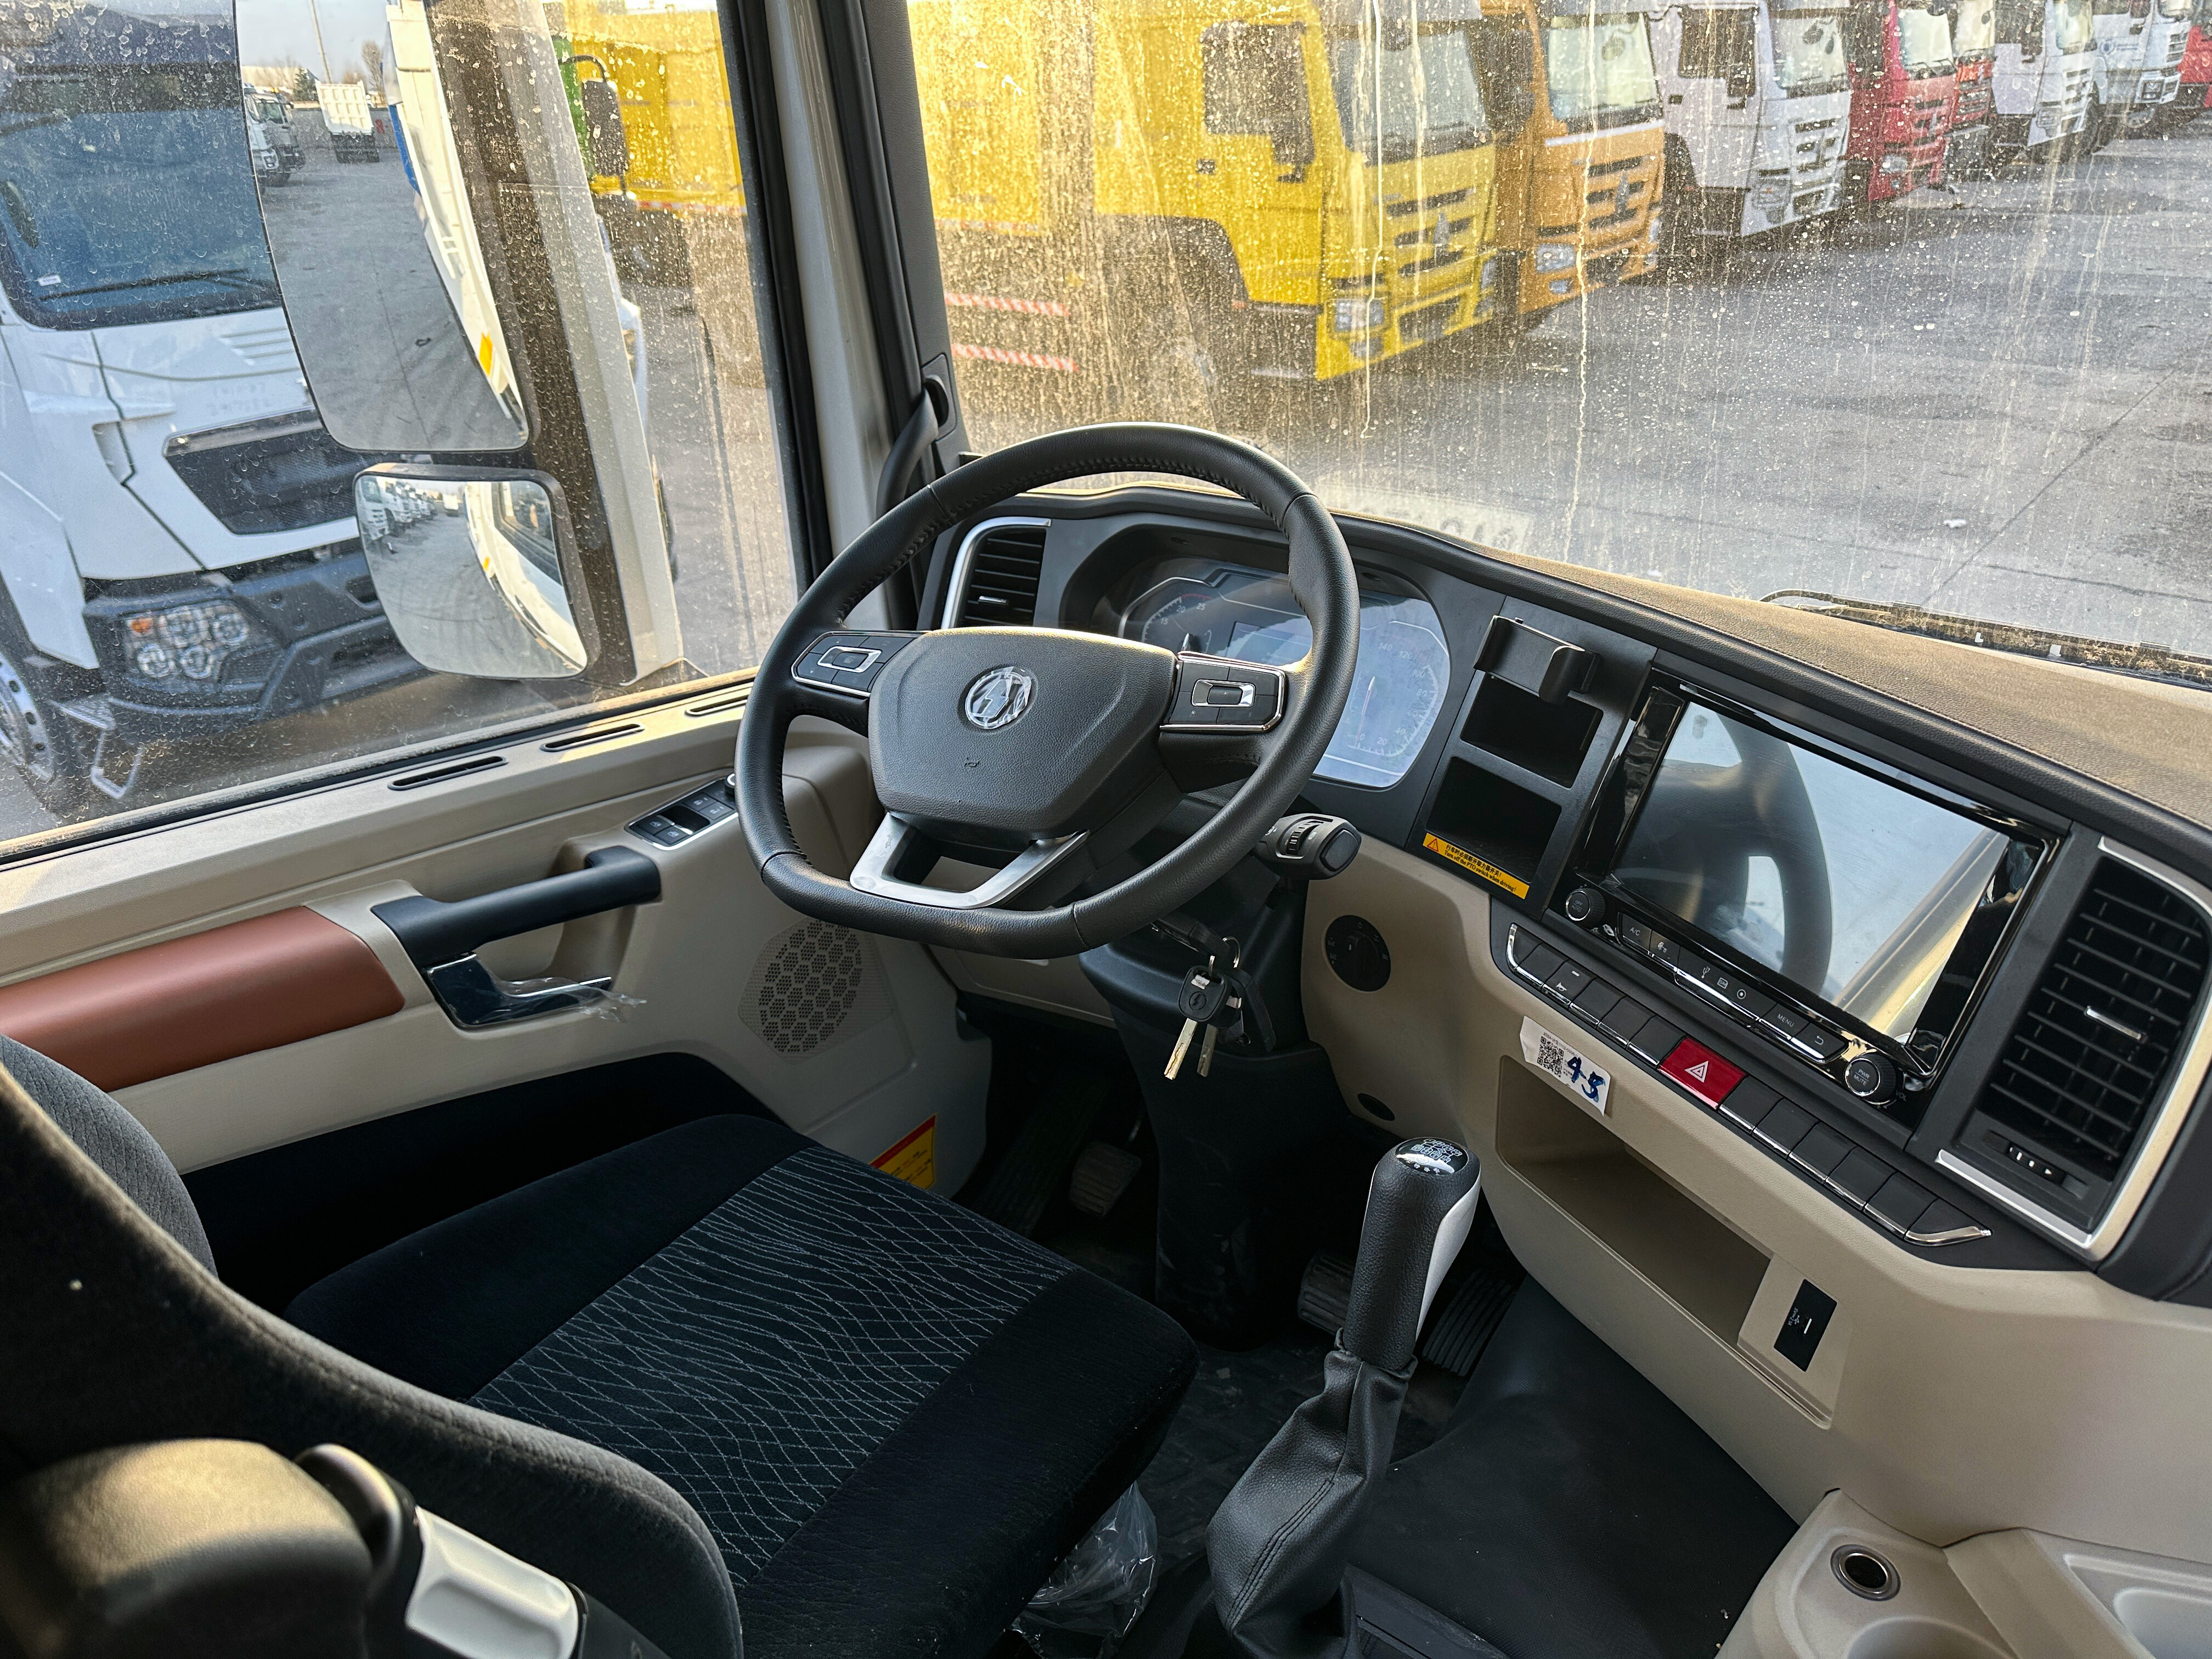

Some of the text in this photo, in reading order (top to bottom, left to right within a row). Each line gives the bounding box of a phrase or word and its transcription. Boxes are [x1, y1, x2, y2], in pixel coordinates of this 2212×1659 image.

[1176, 605, 1186, 613] 20
[1379, 642, 1393, 651] 140
[1377, 737, 1388, 746] 20
[1444, 850, 1454, 859] Turn
[1466, 862, 1476, 870] PTO
[1476, 868, 1489, 878] switch
[1489, 874, 1500, 883] when
[1629, 927, 1641, 936] A/C
[1777, 1013, 1795, 1028] MENU
[1858, 1069, 1870, 1079] PWR
[1853, 1074, 1867, 1086] MUTE
[1895, 1090, 1907, 1101] VOL
